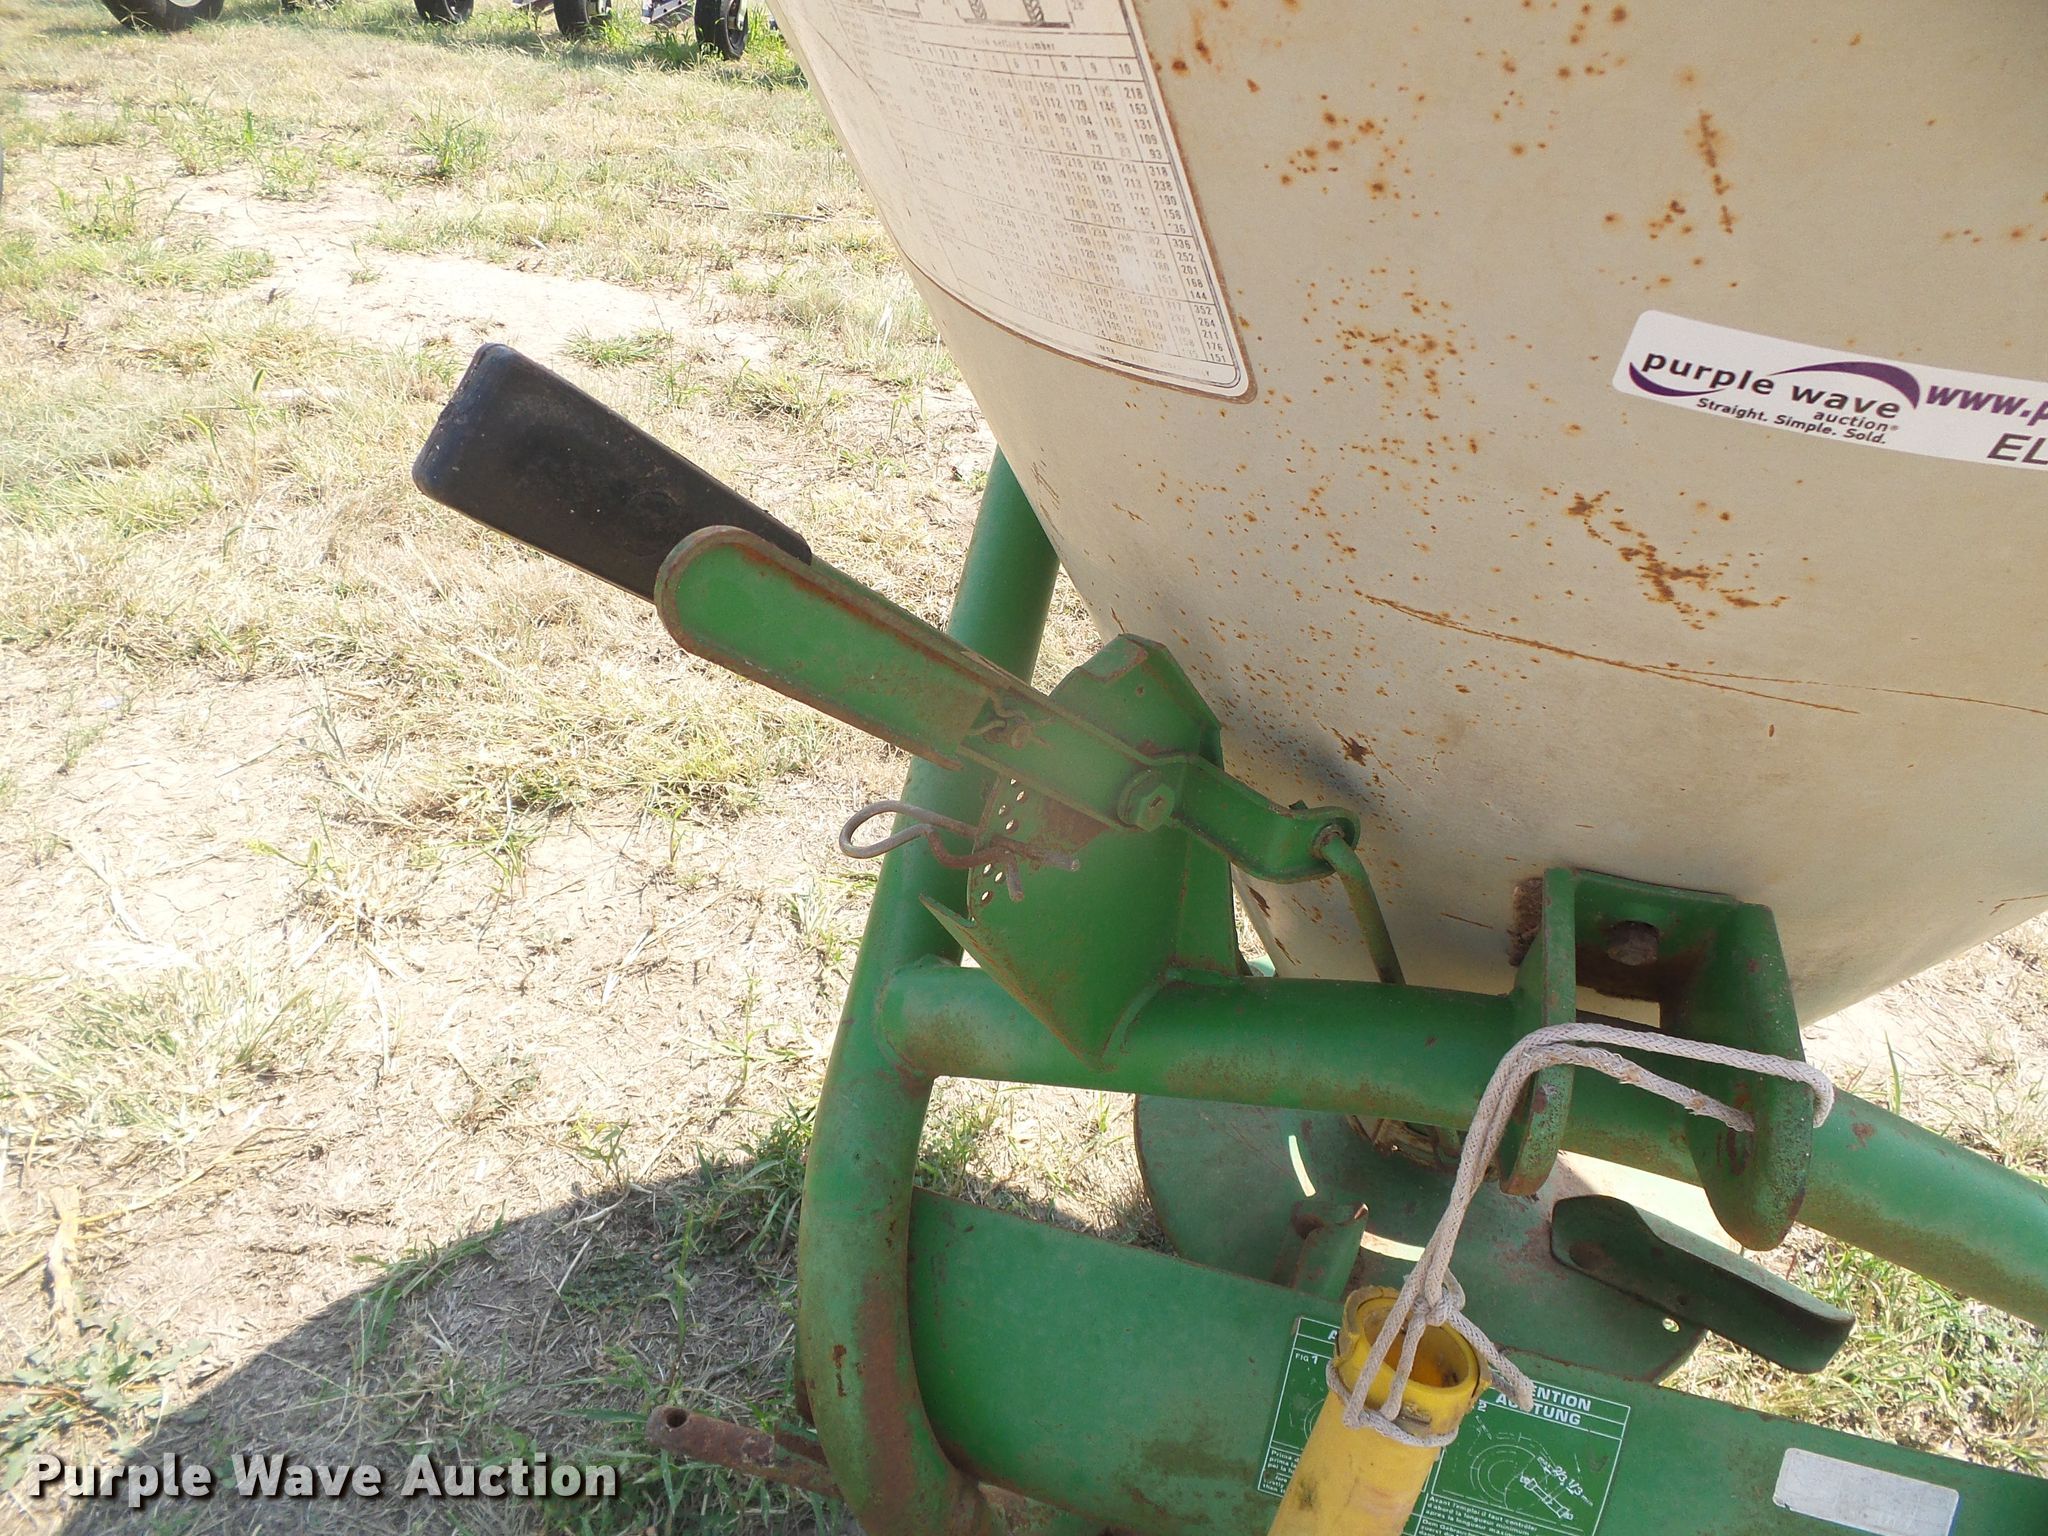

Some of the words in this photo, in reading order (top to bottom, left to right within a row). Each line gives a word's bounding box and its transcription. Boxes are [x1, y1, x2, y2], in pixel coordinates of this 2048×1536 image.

[1118, 63, 1132, 75] 10
[1064, 83, 1083, 96] 173
[1123, 87, 1144, 100] 218
[1138, 133, 1158, 146] 109
[1148, 148, 1163, 160] 93
[1148, 165, 1169, 177] 318
[1153, 179, 1174, 192] 238
[1176, 251, 1196, 264] 252
[1180, 264, 1200, 276] 201
[1189, 289, 1208, 301] 144
[1193, 304, 1213, 317] 352
[1197, 317, 1217, 330] 264
[1201, 328, 1220, 341] 211
[1209, 352, 1228, 364] 151
[1641, 353, 1775, 395] purple
[1791, 385, 1900, 419] wave
[1697, 397, 1769, 423] Straight.
[1773, 414, 1838, 437] Simple.
[1842, 426, 1886, 445] Sold.
[1295, 1353, 1309, 1362] FIG
[1311, 1355, 1319, 1365] 1
[1494, 1391, 1581, 1426] ATUNG
[1271, 1450, 1292, 1461] Prima
[1568, 1479, 1583, 1496] 1/3
[1429, 1496, 1451, 1507] Avant
[1422, 1518, 1439, 1528] Dem
[1455, 1517, 1486, 1530] longueur
[1463, 1512, 1495, 1526] longueur
